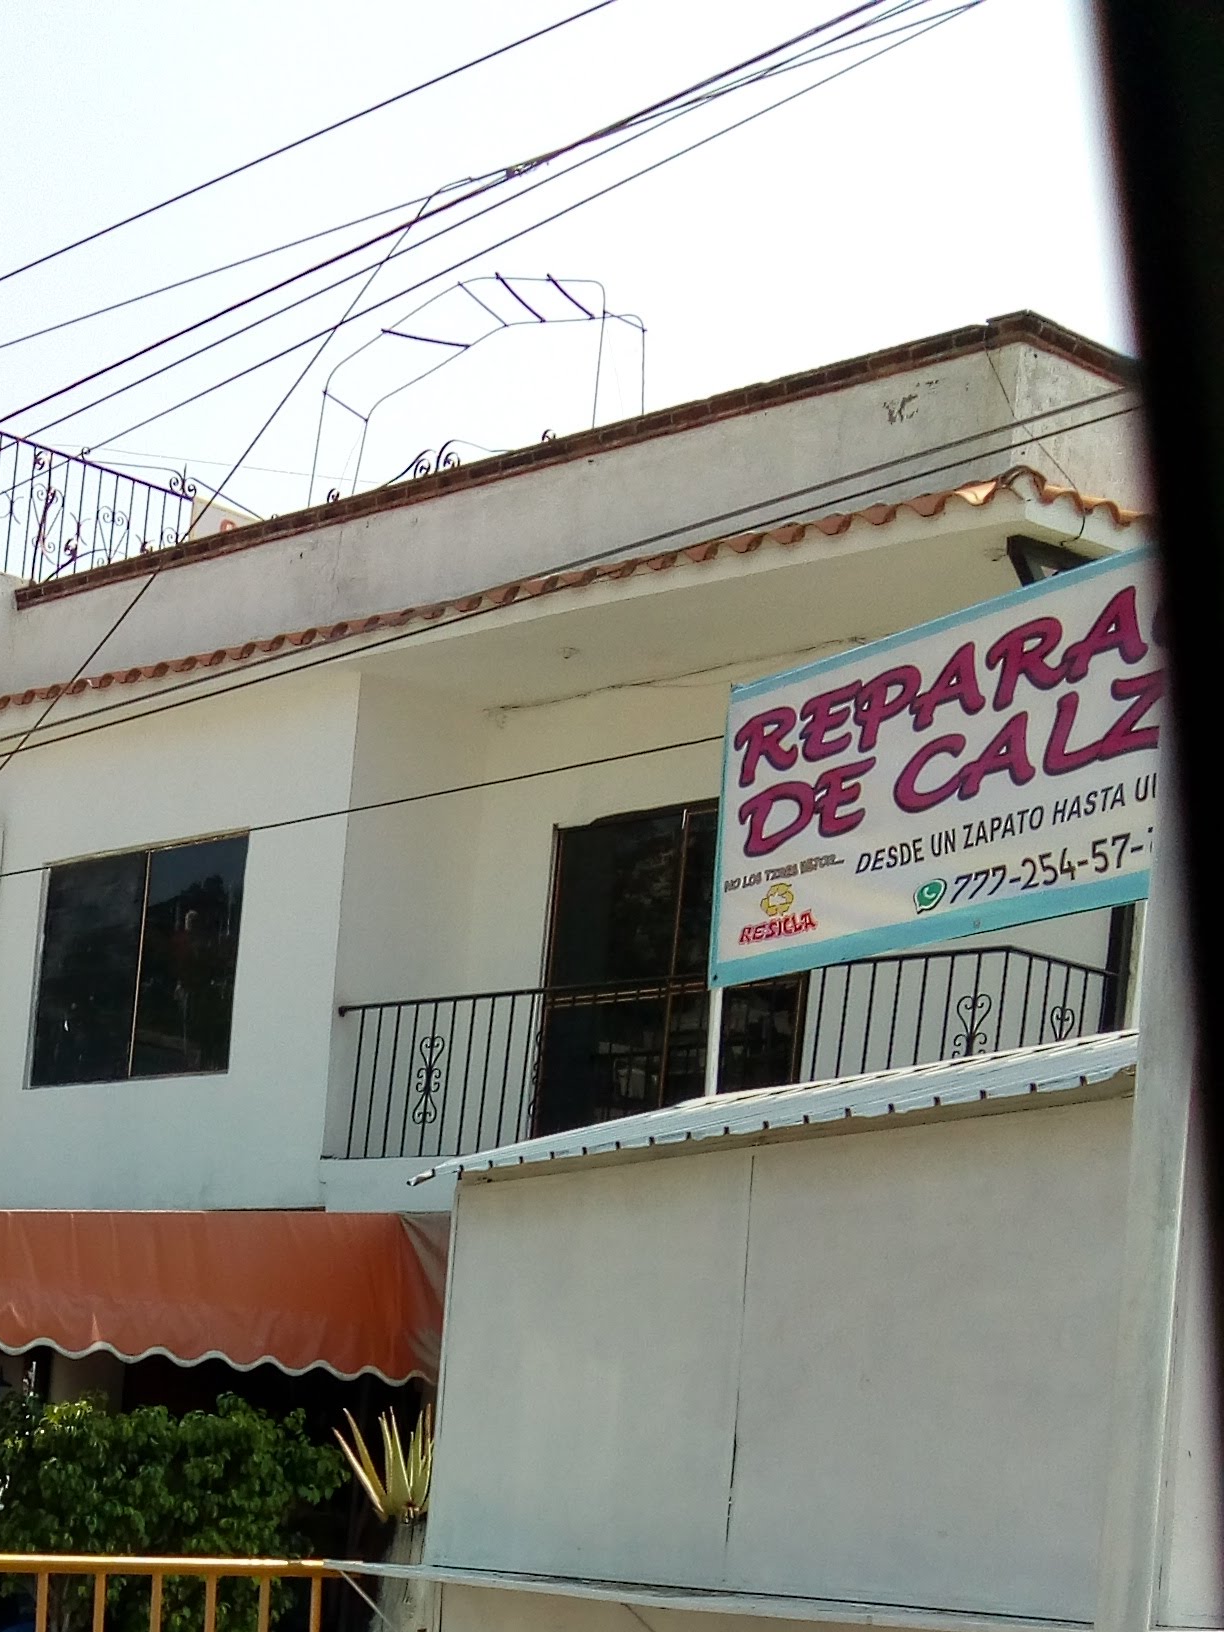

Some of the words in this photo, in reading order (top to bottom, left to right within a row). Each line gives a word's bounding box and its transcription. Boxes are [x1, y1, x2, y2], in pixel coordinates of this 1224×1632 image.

[733, 585, 1167, 788] REPARA
[738, 756, 877, 859] DE
[892, 668, 1165, 815] CALZ
[855, 838, 925, 874] DESDE
[930, 829, 956, 858] UN
[962, 805, 1045, 851] ZAPATO
[1051, 783, 1126, 826] HASTA
[949, 826, 1153, 904] 777-254-57-
[738, 908, 819, 945] RESICLA
